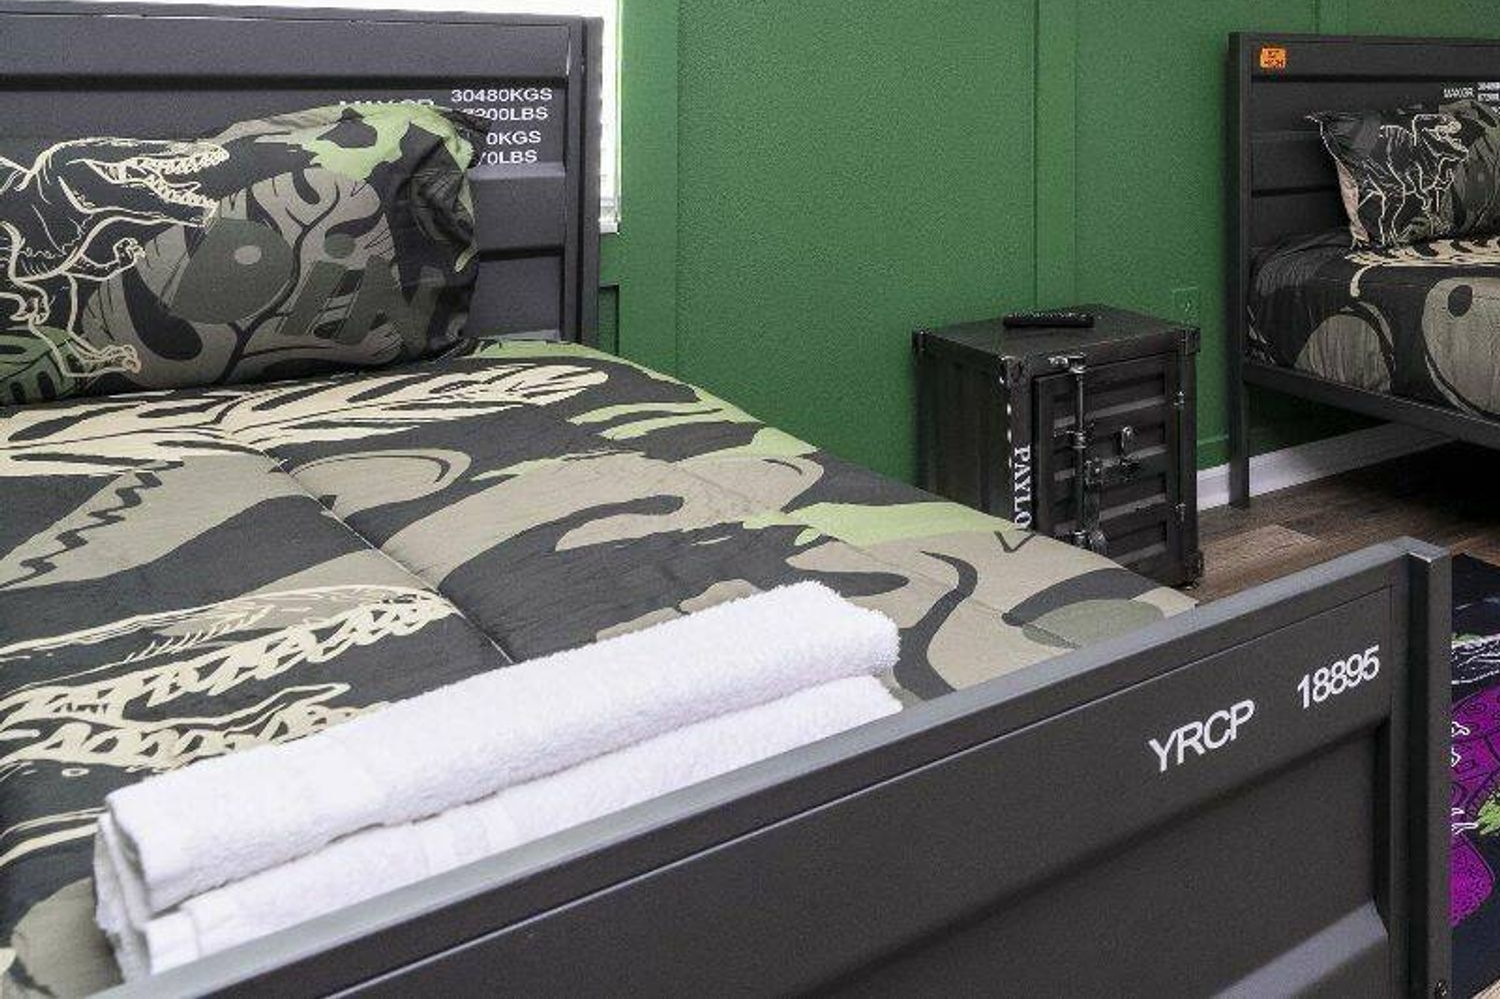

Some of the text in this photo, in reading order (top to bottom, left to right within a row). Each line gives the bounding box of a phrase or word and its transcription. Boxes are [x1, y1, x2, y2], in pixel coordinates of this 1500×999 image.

[451, 88, 553, 102] 30480KGS
[462, 106, 549, 121] 200LBS
[1148, 644, 1381, 772] YRCP 18895
